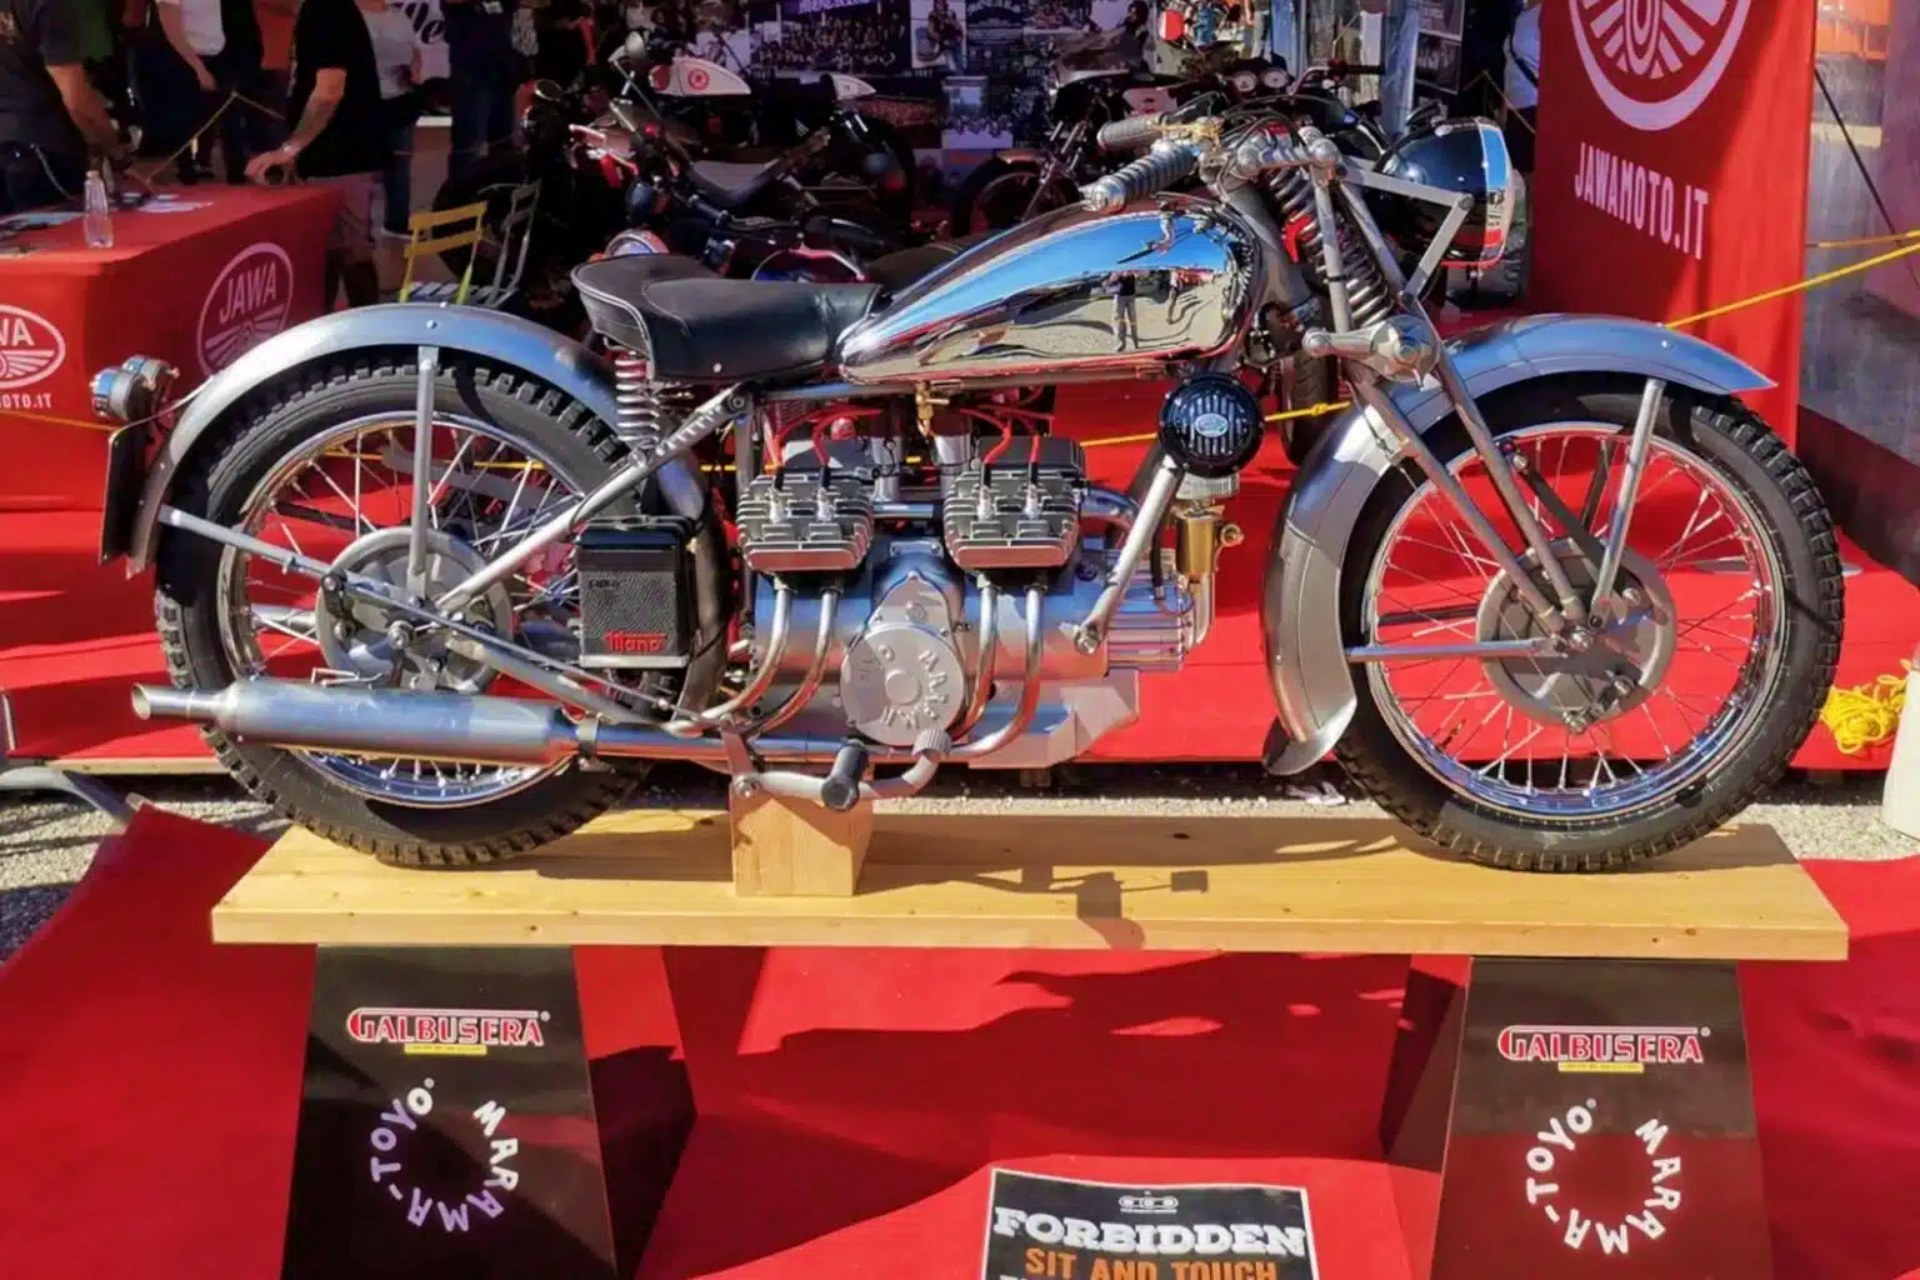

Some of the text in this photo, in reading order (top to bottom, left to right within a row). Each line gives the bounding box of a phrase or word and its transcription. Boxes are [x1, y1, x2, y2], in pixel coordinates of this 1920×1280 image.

[1574, 141, 1709, 260] JAWAMOTO.IT
[219, 261, 277, 324] JAWA
[347, 1007, 544, 1046] GALBUSERA
[1498, 1025, 1704, 1063] GALBUSERA
[993, 1206, 1306, 1257] FORBIDDEN
[1025, 1248, 1278, 1280] SIT AND TOUCH
